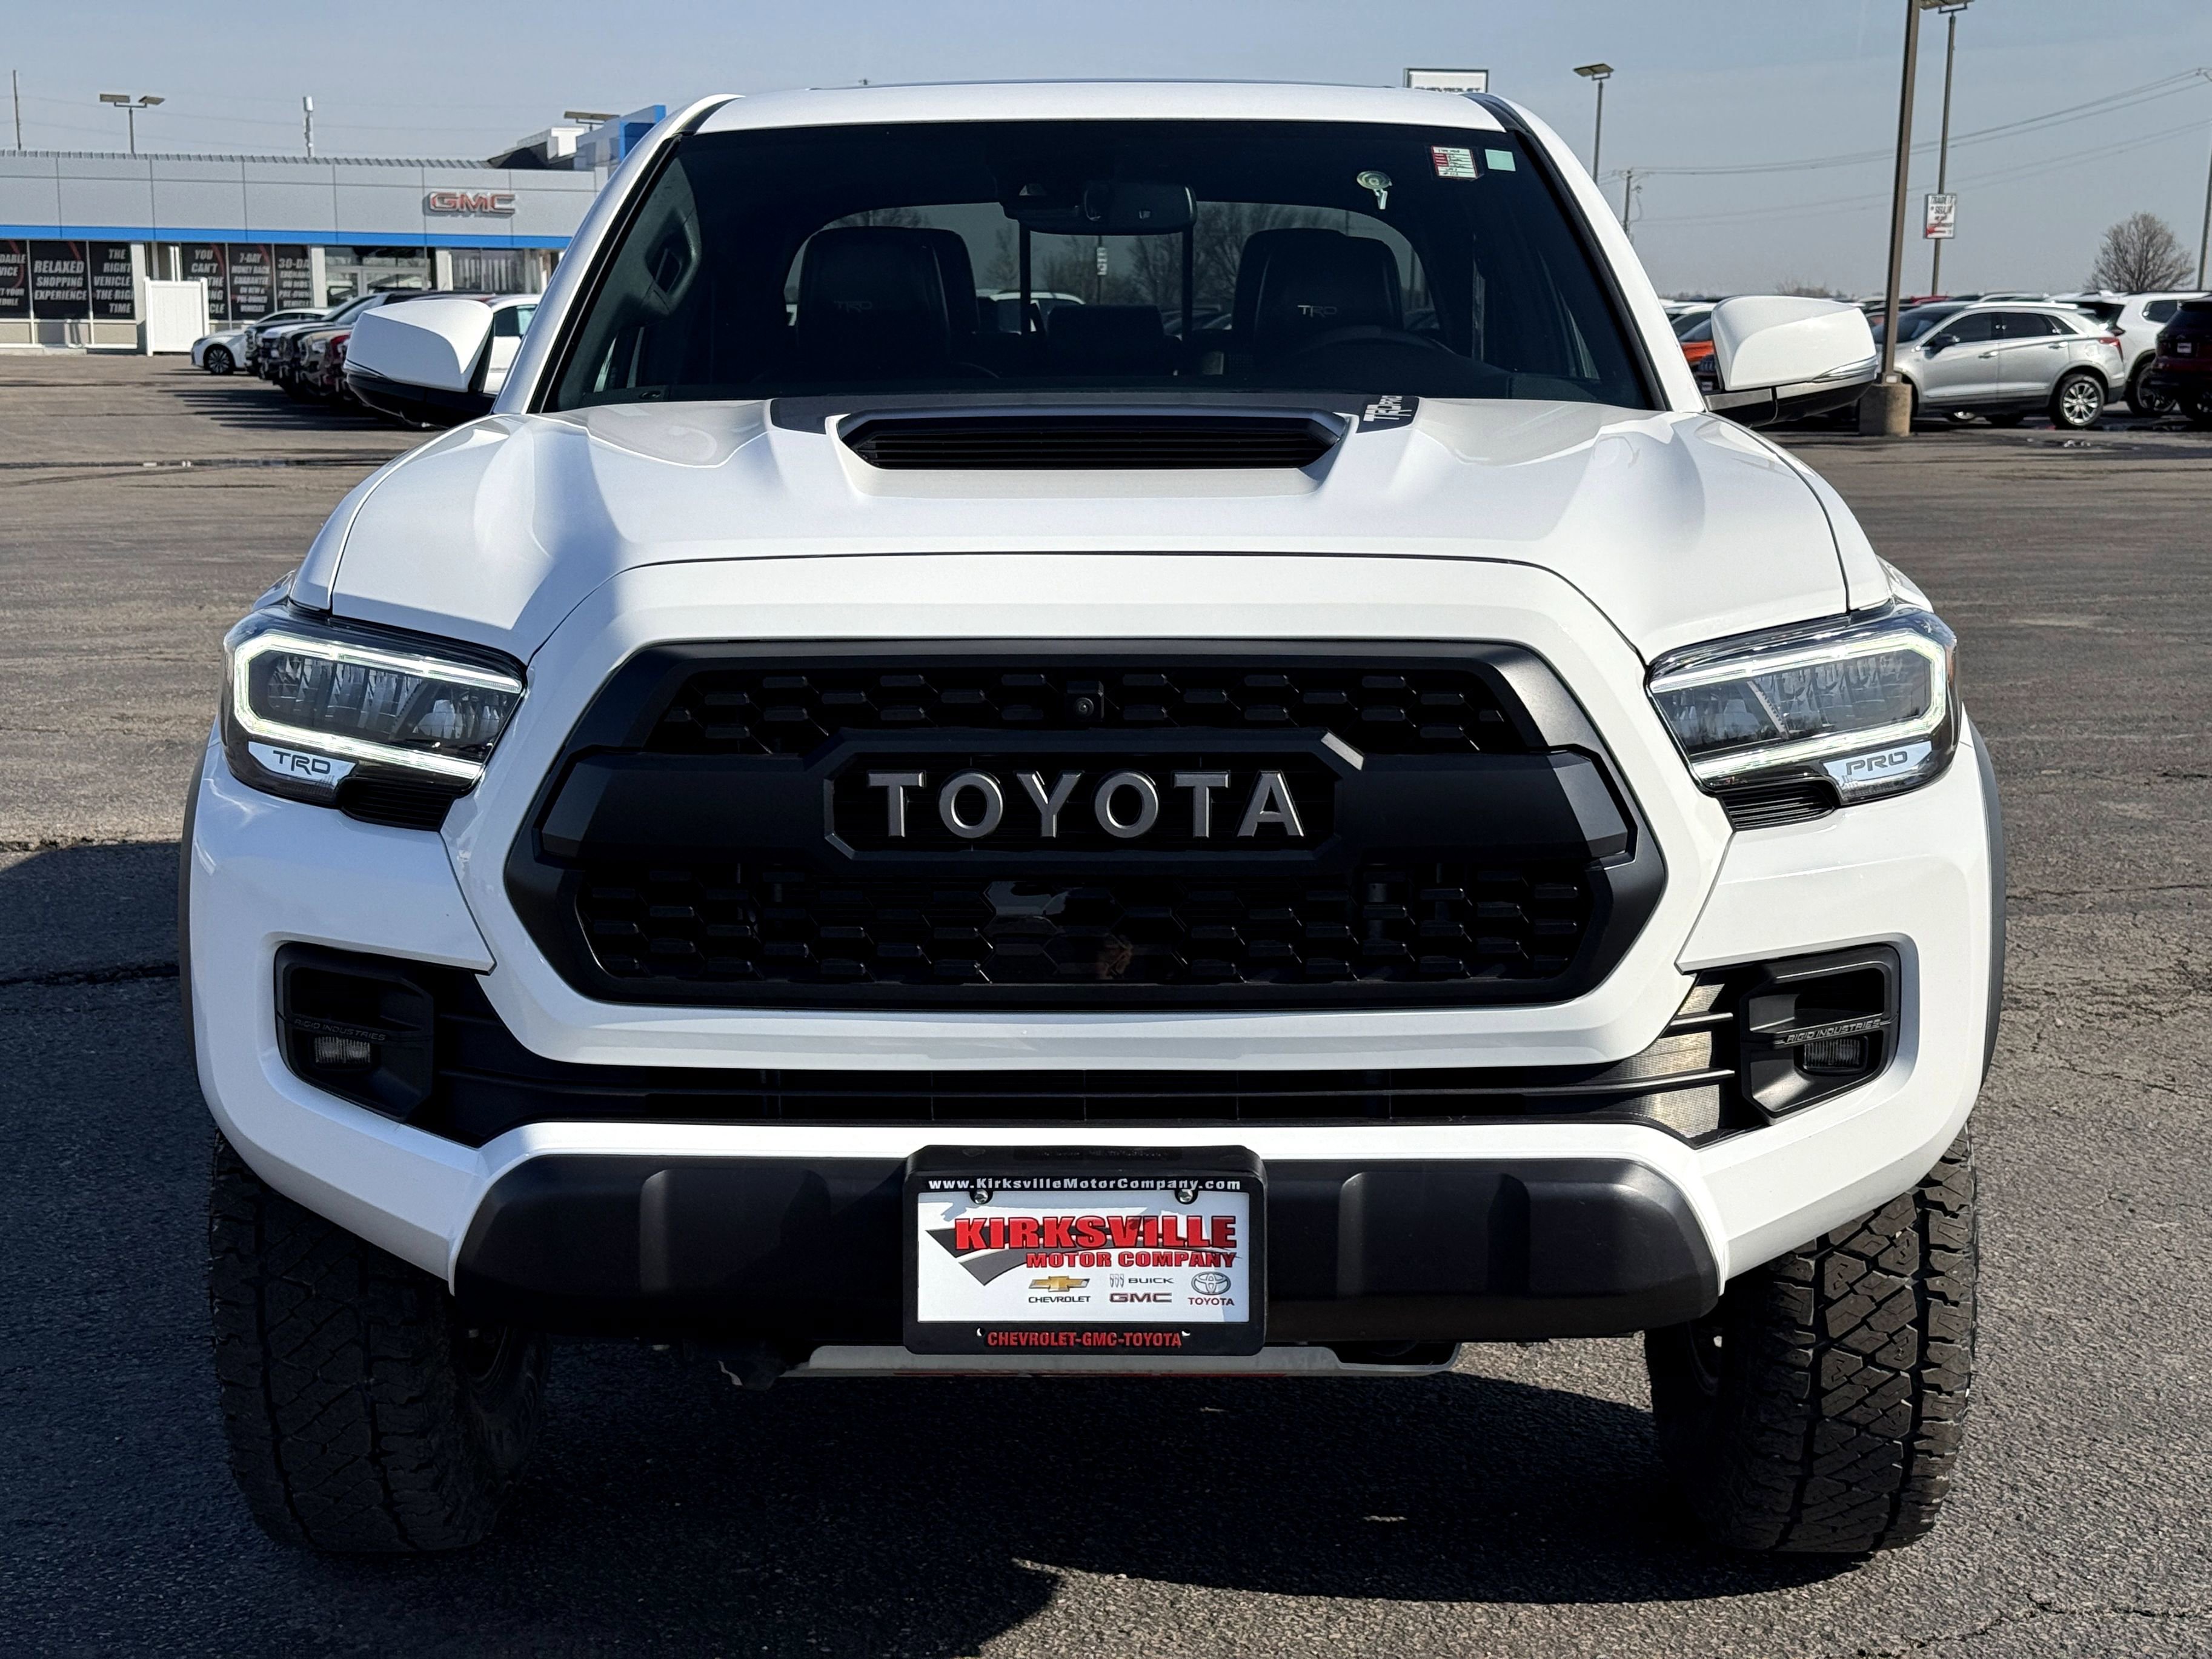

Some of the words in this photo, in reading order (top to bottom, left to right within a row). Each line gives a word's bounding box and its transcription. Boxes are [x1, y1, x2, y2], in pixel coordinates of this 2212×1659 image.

[430, 192, 517, 214] GMC
[108, 248, 126, 260] THE
[195, 249, 213, 260] YOU
[239, 252, 262, 263] 7-DAY
[34, 260, 85, 273] RELAXED
[103, 262, 131, 273] RIGHT
[191, 262, 218, 274] CAN'T
[36, 276, 84, 287] SHOPPING
[94, 276, 131, 287] VEHICLE
[208, 276, 225, 287] THE
[234, 276, 269, 285] GUARANTEE
[34, 290, 87, 301] EXPERIENCE
[96, 290, 115, 301] THE
[108, 303, 131, 313] TIME
[1297, 305, 1337, 318] TRD
[272, 750, 331, 776] TRD
[1845, 750, 1908, 776] PRO
[866, 769, 1306, 839] TOYOTA
[294, 1019, 321, 1029] RIGID
[322, 1023, 387, 1041] INDUSTRIES
[1787, 1031, 1815, 1042] RIGID
[1816, 1019, 1881, 1037] INDUSTRIES
[928, 1177, 1241, 1191] www.KirksvilleMotorCompany.com
[954, 1215, 1237, 1251] KIRKSVILLE
[1026, 1251, 1112, 1268] MOTOR
[1118, 1251, 1237, 1268] COMPANY
[1109, 1292, 1172, 1303] GMC
[1187, 1297, 1235, 1306] TOYOTA
[987, 1332, 1183, 1347] CHEVROLET-GMC-TOYOTA
